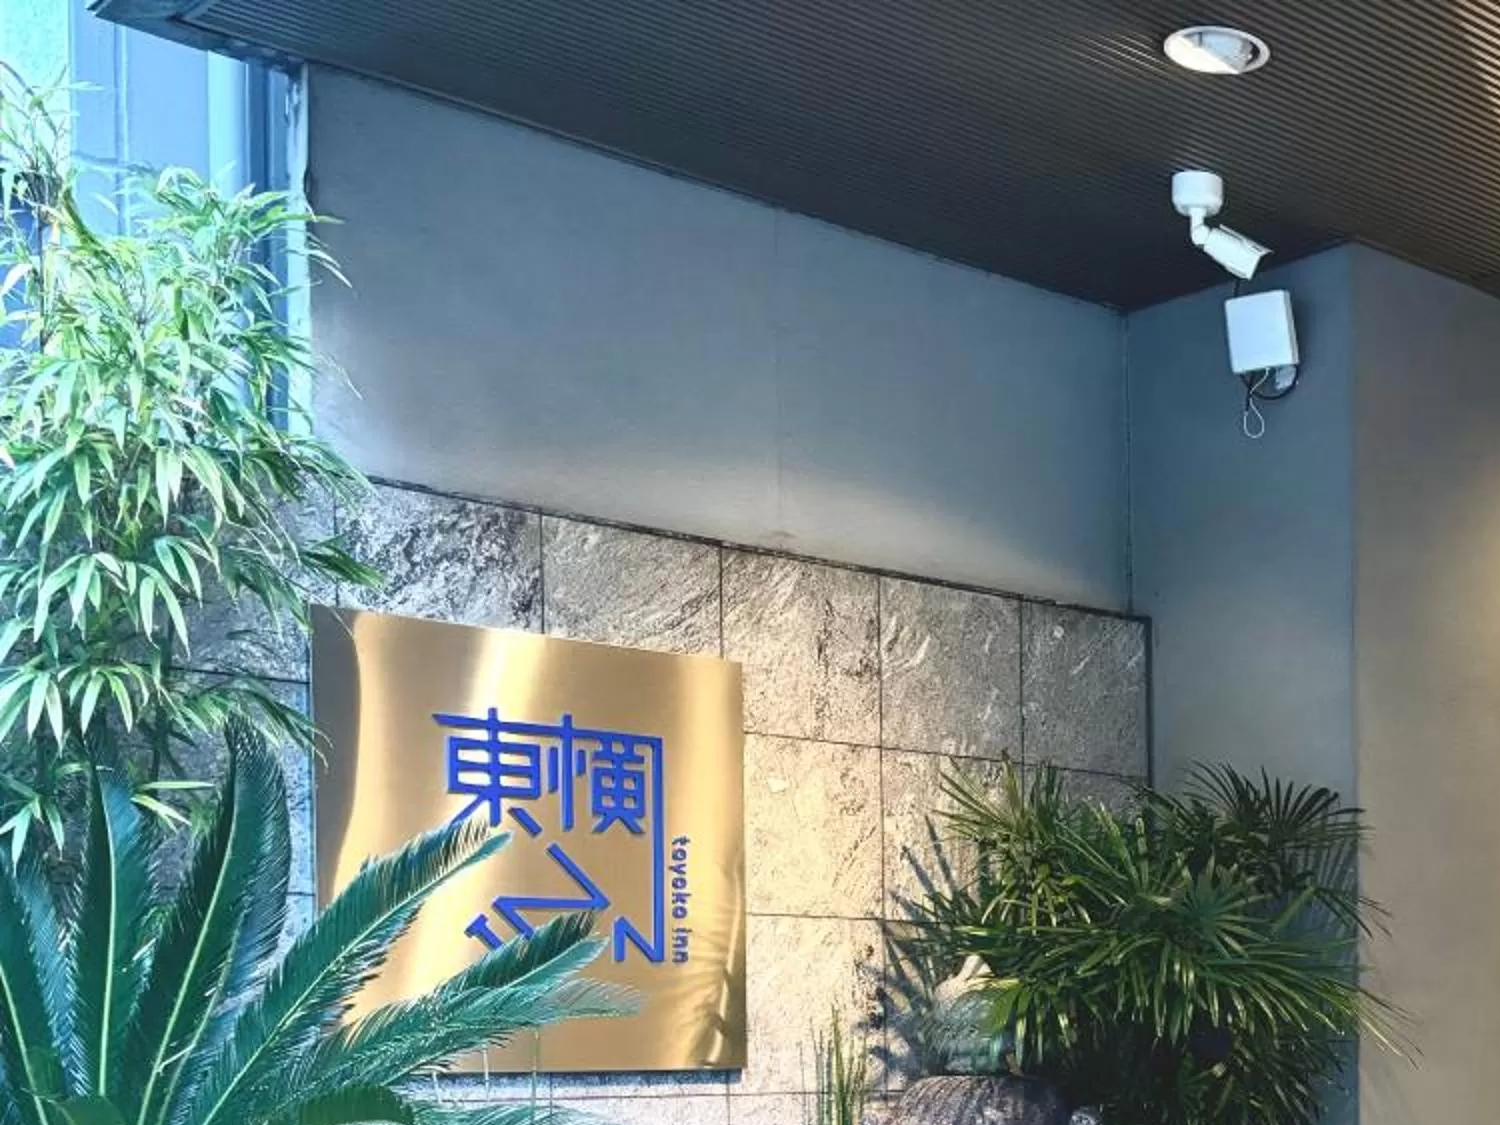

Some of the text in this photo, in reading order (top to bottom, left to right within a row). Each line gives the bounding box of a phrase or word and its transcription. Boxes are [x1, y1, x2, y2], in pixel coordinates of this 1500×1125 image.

[431, 706, 664, 837] 東横
[668, 836, 693, 963] toyoko inn
